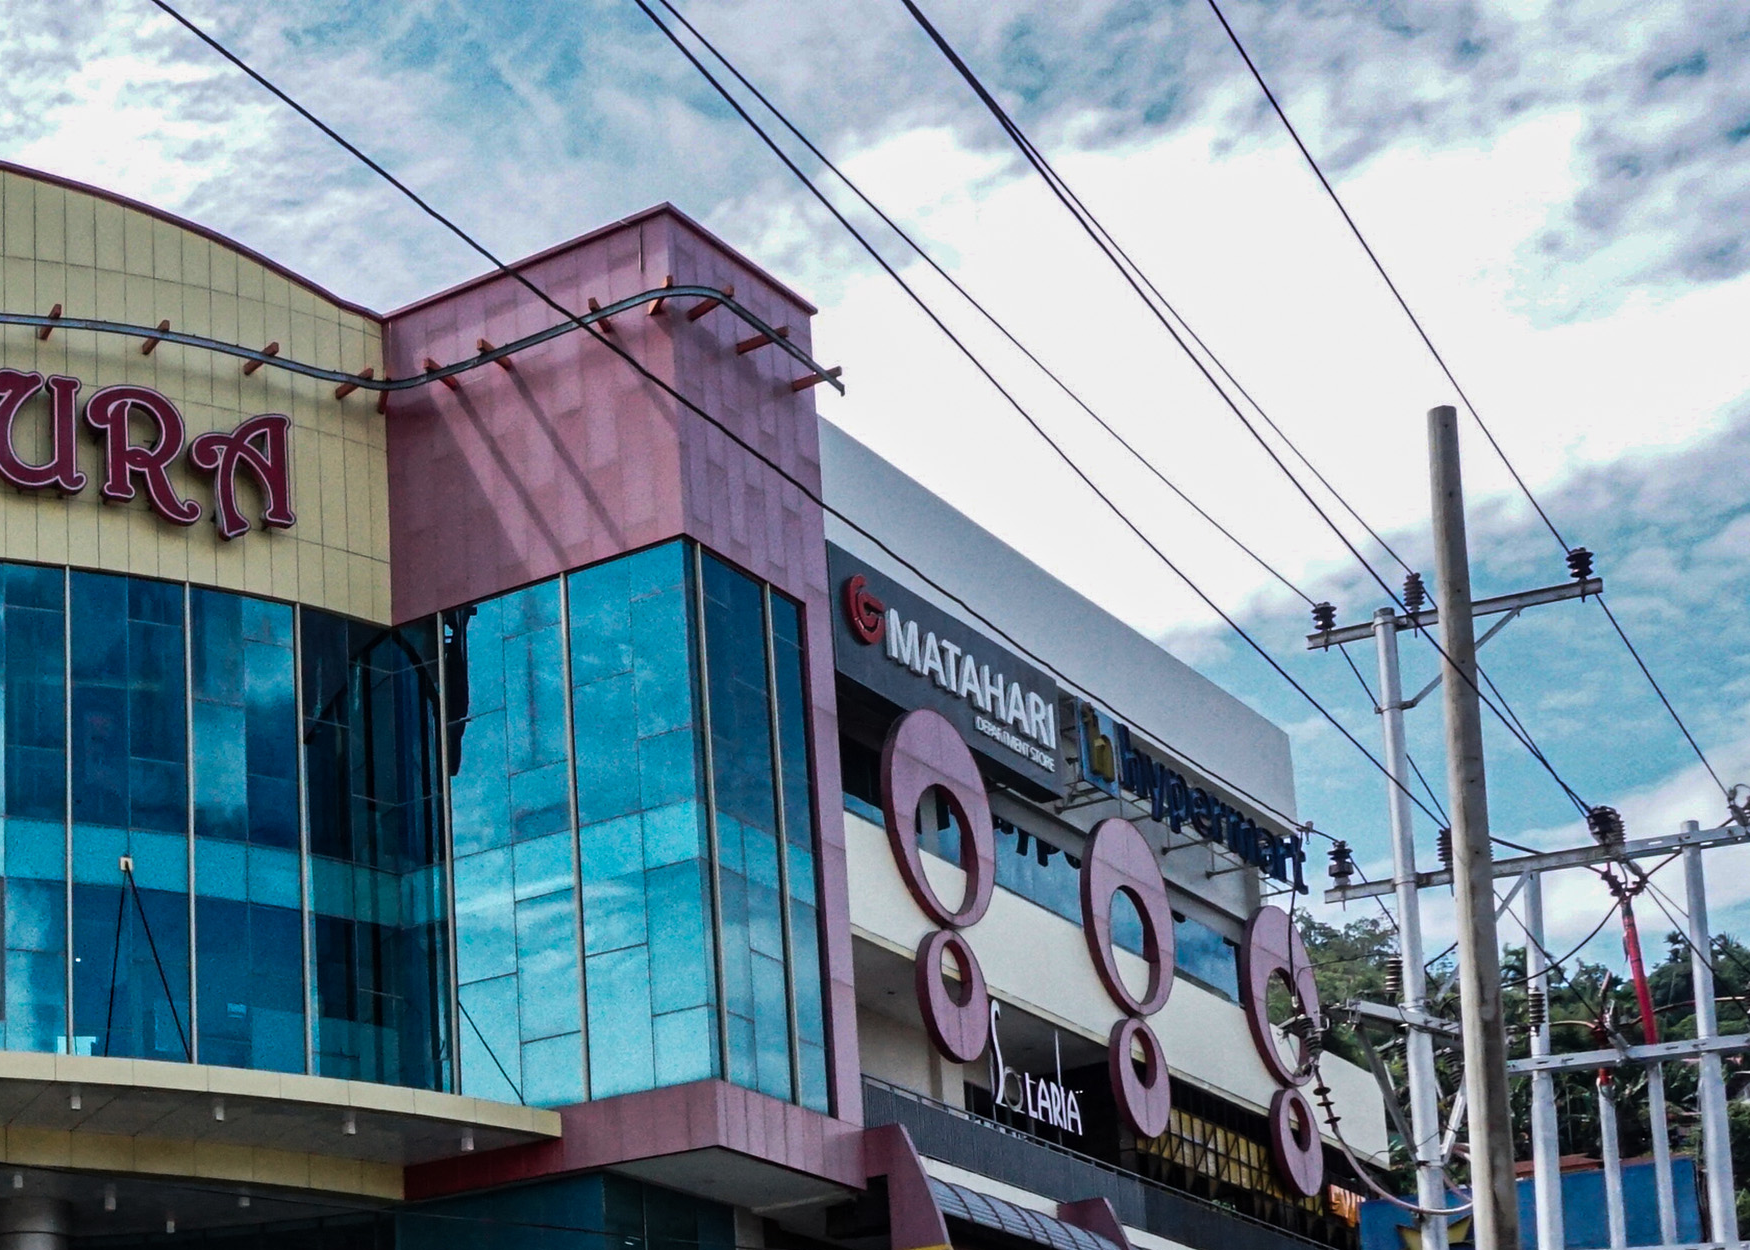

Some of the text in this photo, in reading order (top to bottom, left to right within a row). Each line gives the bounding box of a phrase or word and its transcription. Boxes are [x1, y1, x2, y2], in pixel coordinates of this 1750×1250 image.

[885, 607, 1056, 751] MATAHARI
[974, 715, 1056, 773] DEPARTMENT STORE
[1118, 723, 1309, 895] hypermart
